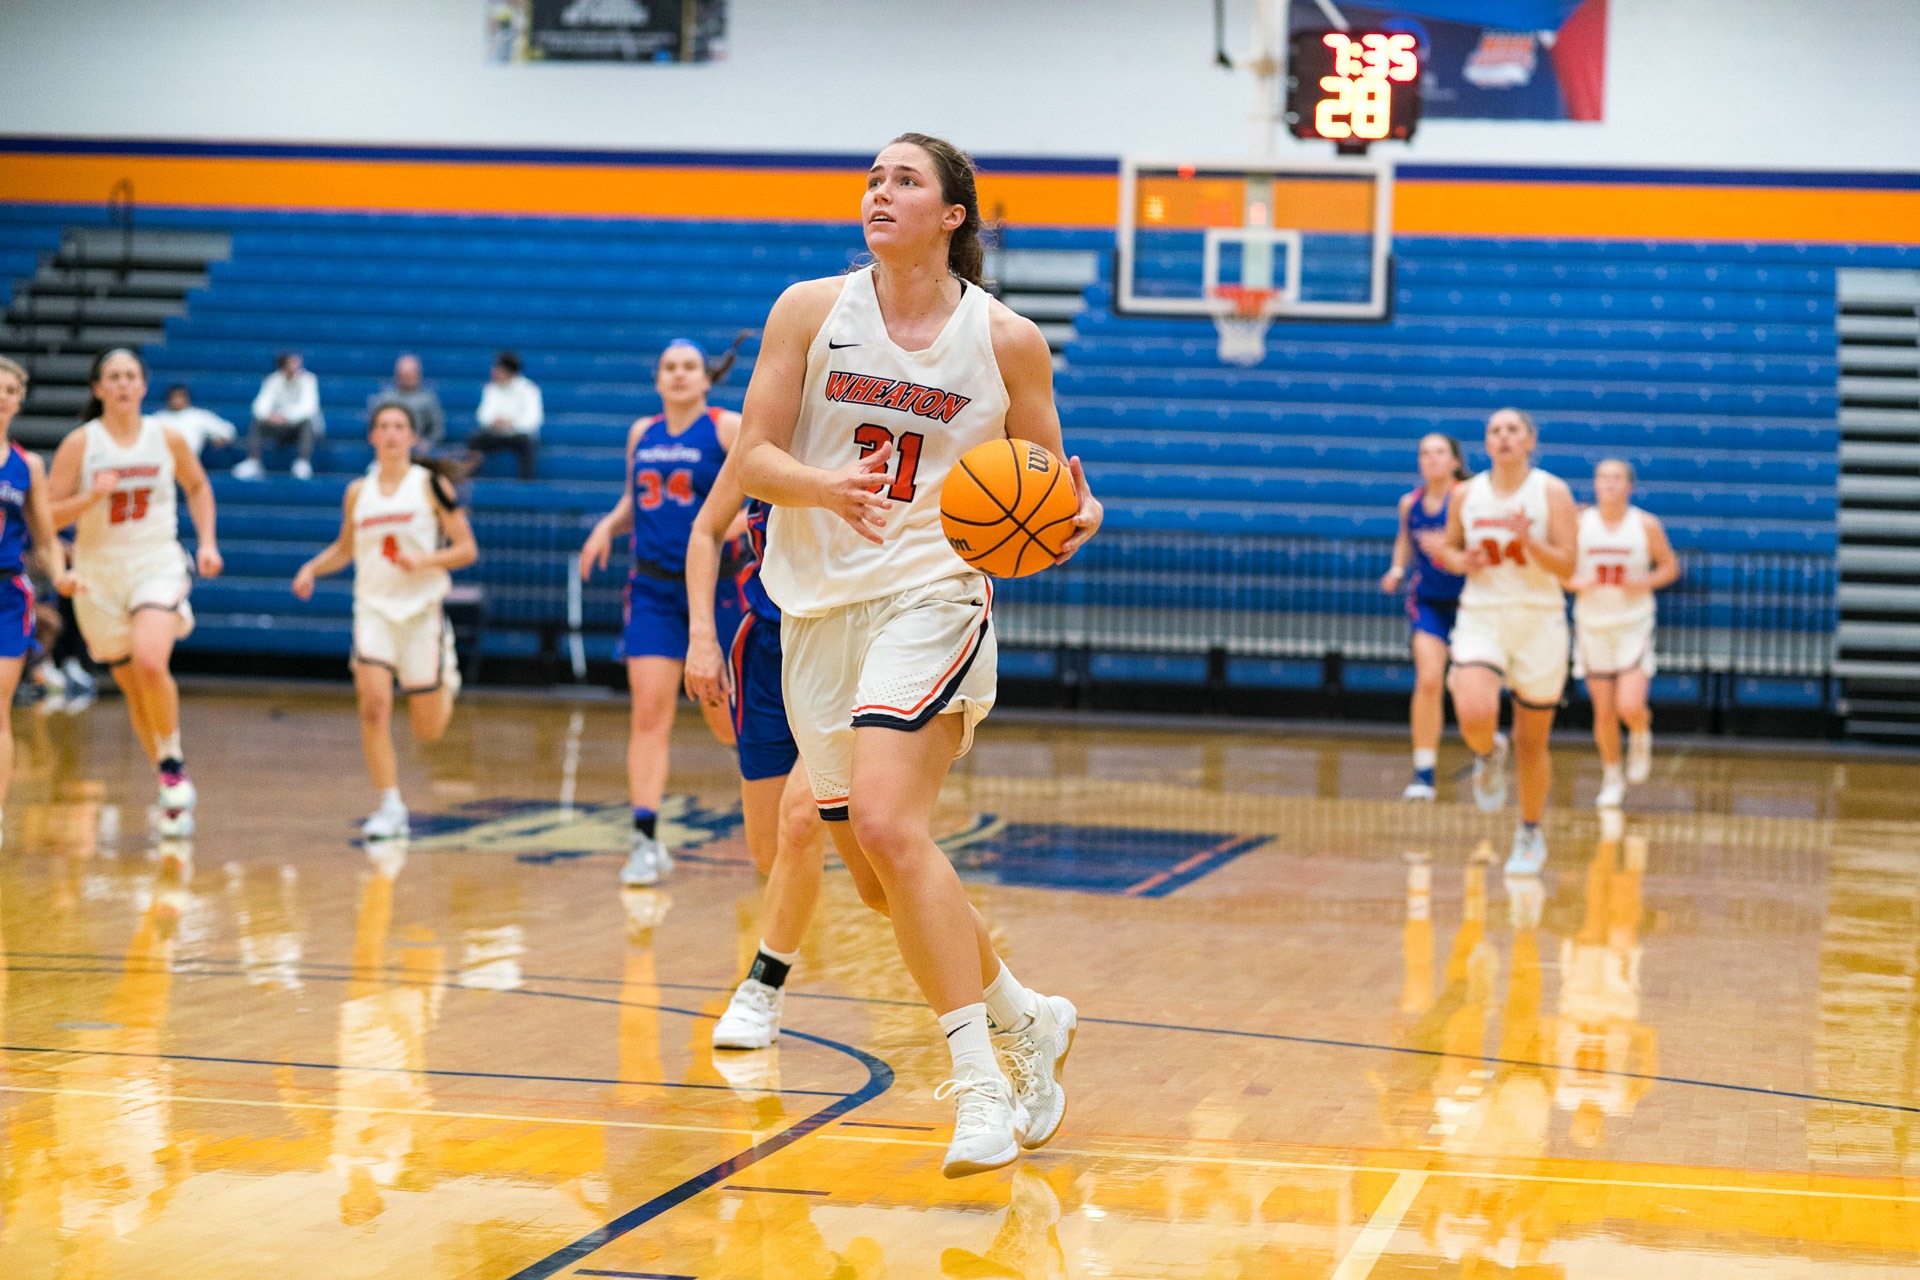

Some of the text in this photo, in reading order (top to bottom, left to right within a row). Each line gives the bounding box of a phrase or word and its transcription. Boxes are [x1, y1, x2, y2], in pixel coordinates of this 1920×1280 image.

[1322, 33, 1418, 81] 7:35
[1314, 75, 1392, 140] 28
[825, 371, 972, 424] WHEATON
[636, 467, 696, 511] 34
